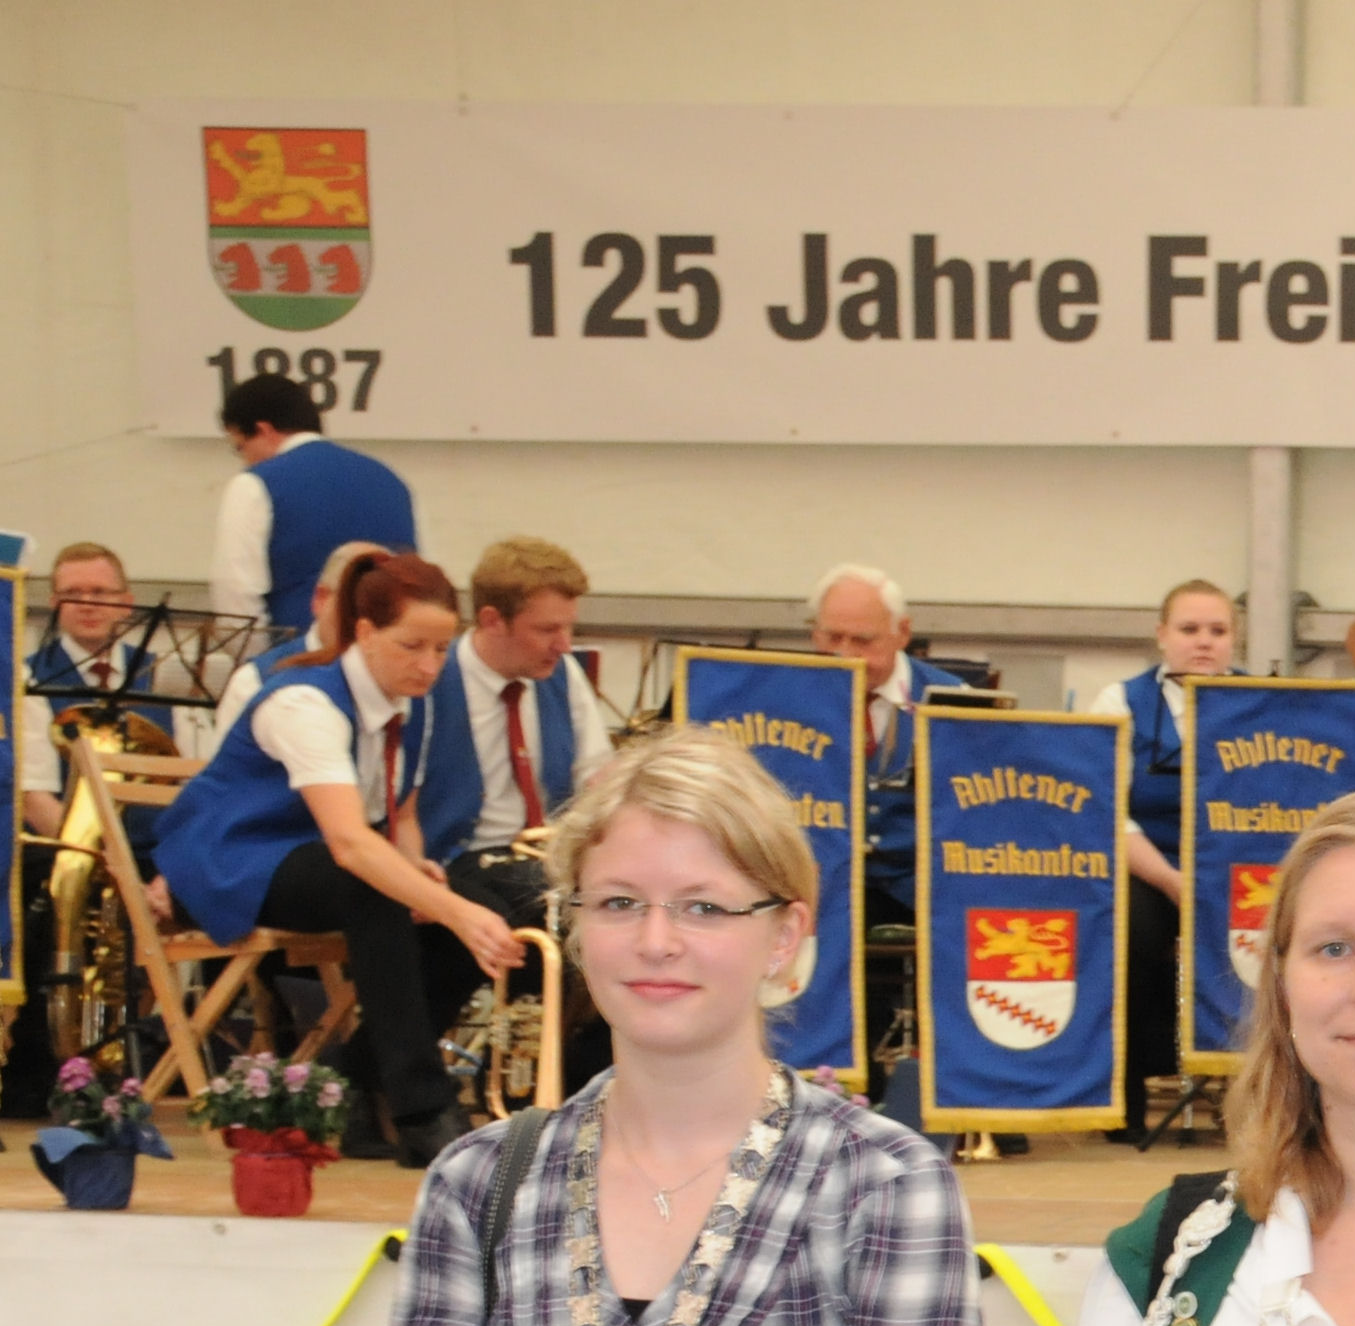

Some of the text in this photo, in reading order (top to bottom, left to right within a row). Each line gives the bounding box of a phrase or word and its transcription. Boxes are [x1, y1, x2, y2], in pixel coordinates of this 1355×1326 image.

[508, 231, 721, 341] 125
[766, 233, 1100, 342] Jahre
[709, 712, 833, 761] hltener
[1216, 731, 1345, 775] Ahltener
[950, 766, 1093, 813] Ahltener
[1206, 801, 1330, 834] Musikan
[942, 840, 1109, 878] Musikanten
